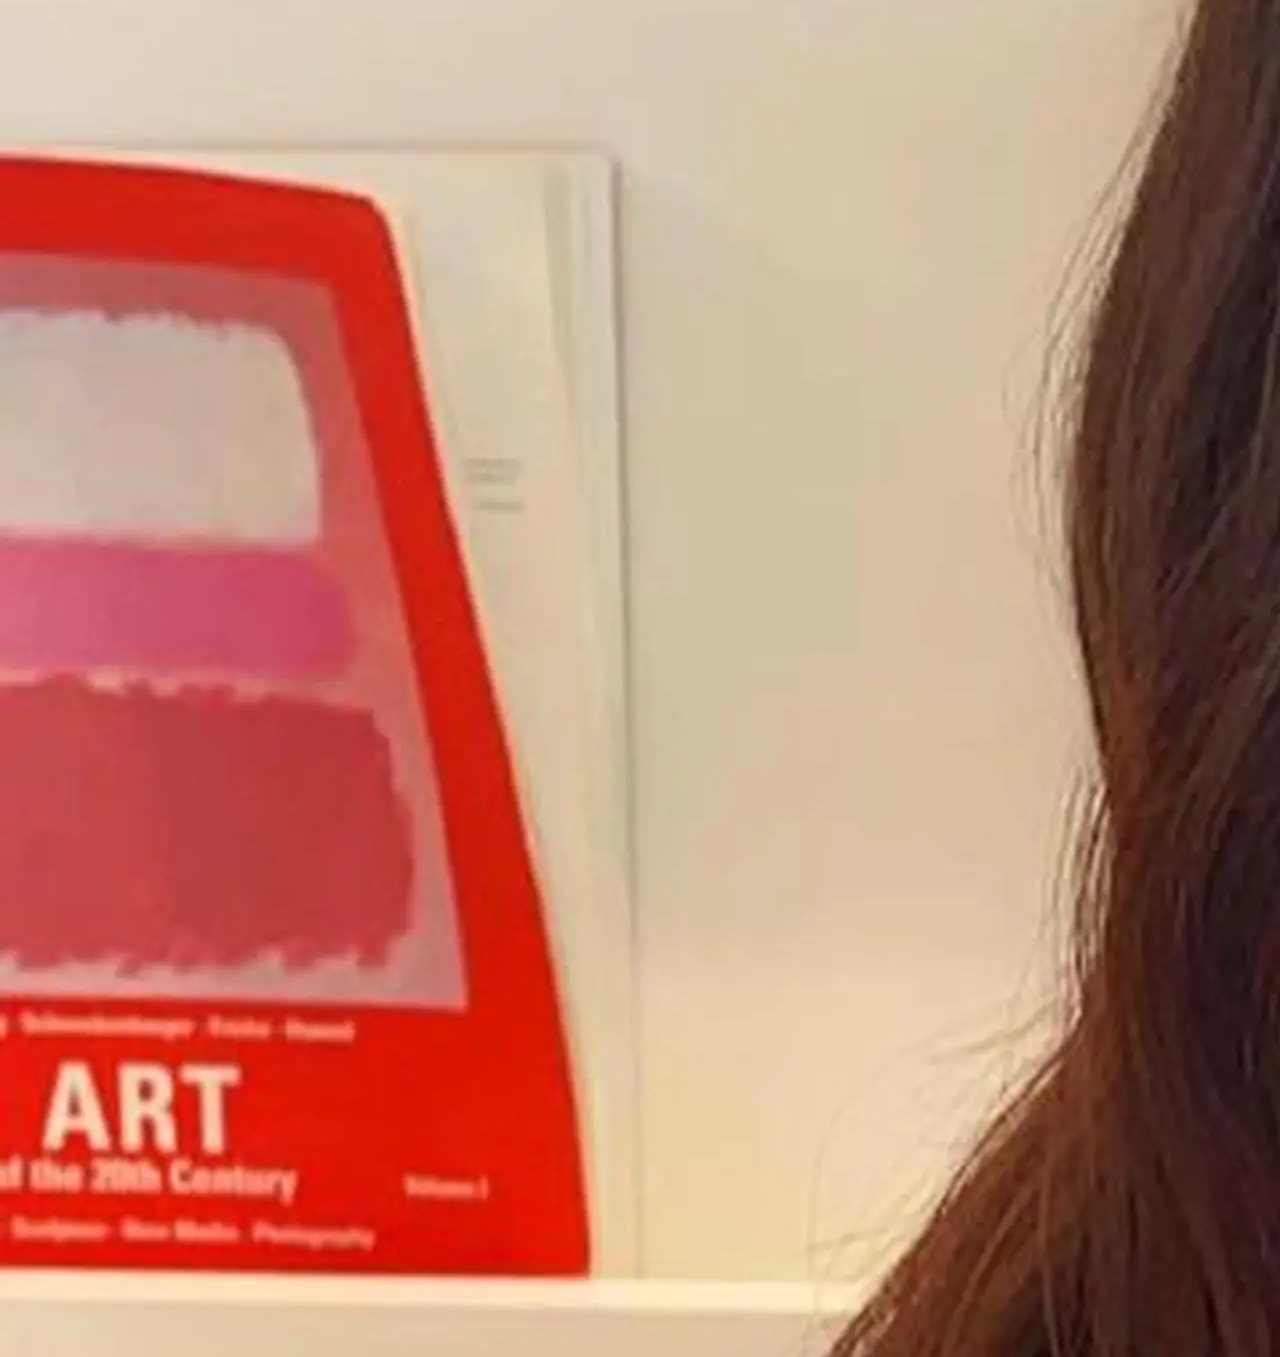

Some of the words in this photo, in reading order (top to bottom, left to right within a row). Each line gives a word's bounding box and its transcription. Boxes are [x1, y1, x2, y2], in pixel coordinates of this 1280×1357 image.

[42, 1060, 241, 1155] ART
[30, 1158, 83, 1191] the
[90, 1157, 162, 1192] 20th
[168, 1158, 297, 1204] Century
